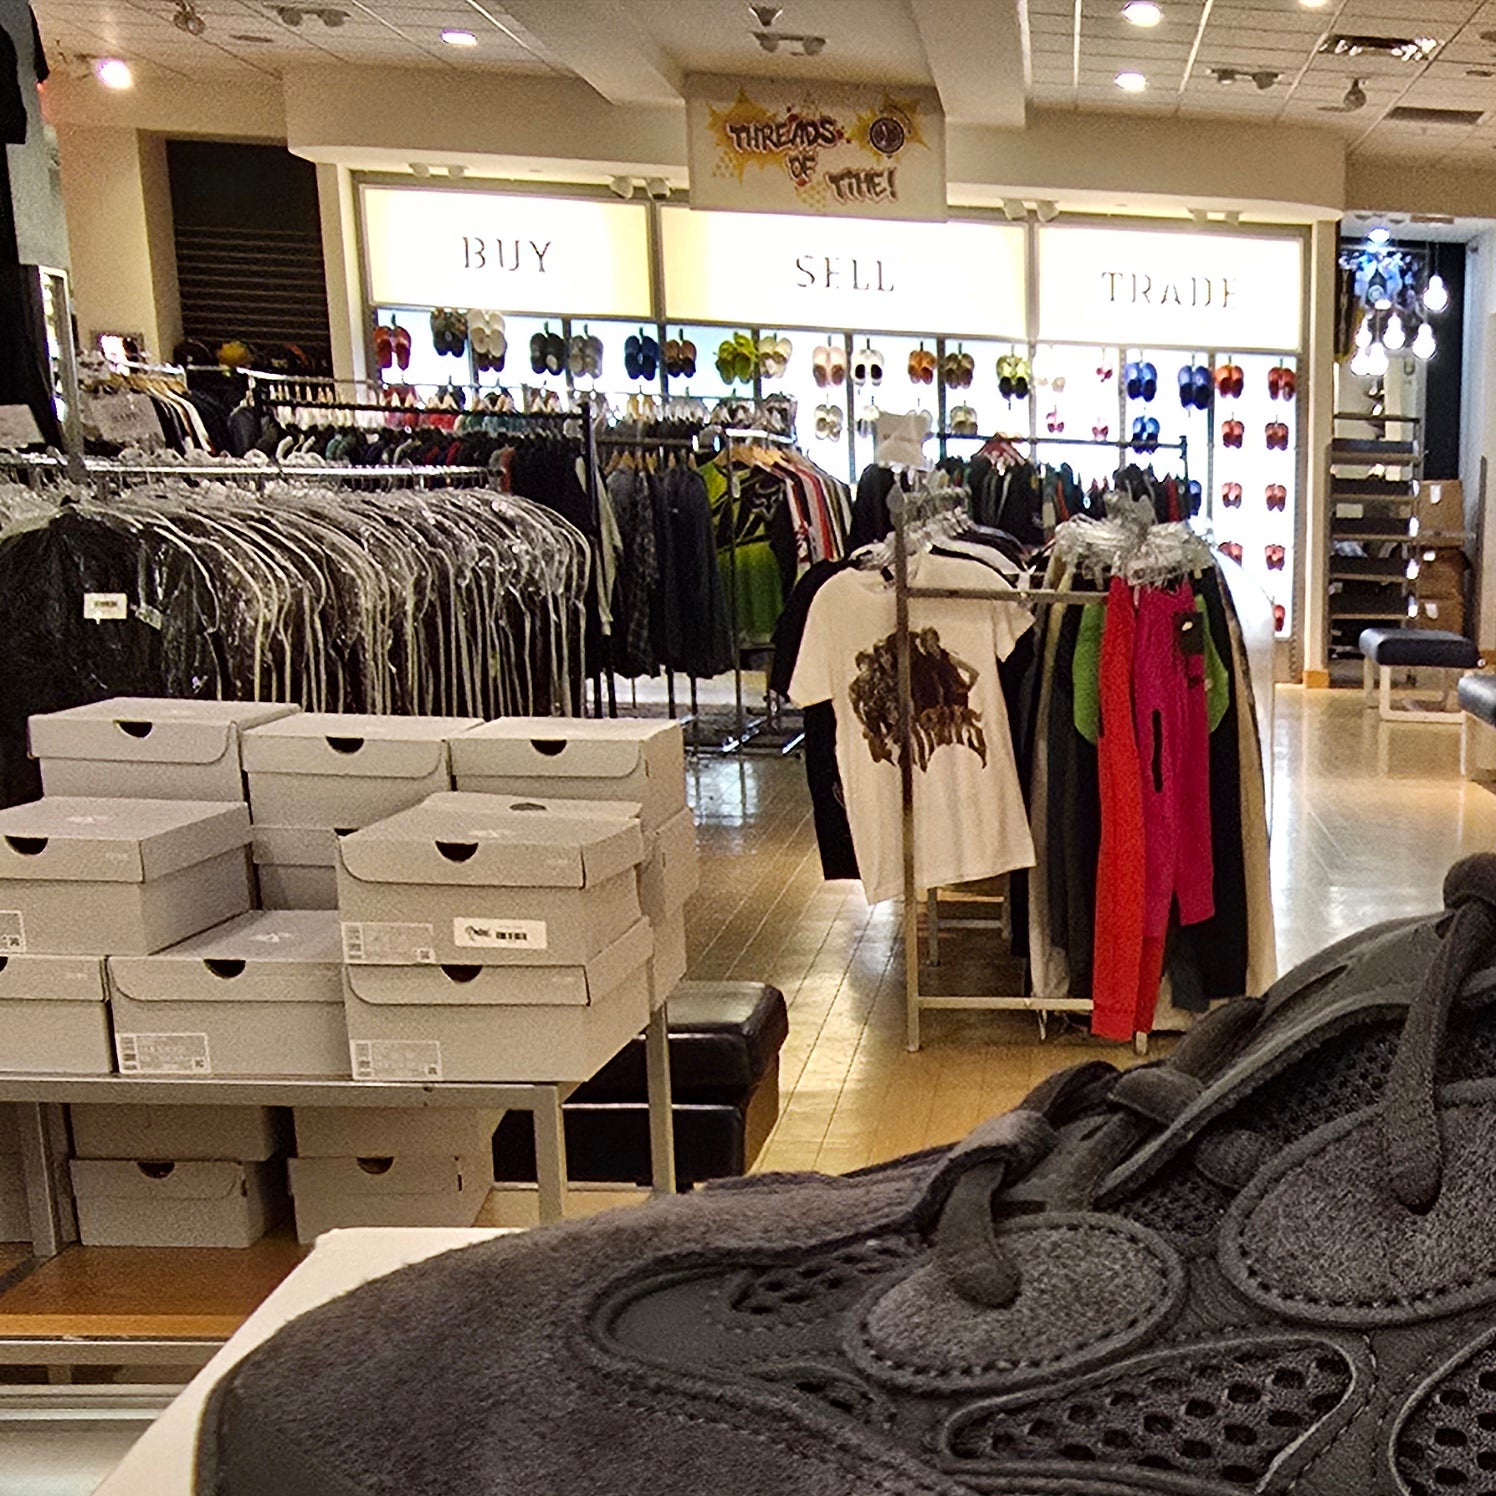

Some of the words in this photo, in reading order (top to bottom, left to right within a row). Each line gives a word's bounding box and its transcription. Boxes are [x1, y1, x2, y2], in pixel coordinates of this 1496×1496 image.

[728, 115, 838, 152] THREADS
[787, 154, 817, 182] OF
[462, 236, 551, 273] BUY
[796, 255, 894, 291] SELL
[1101, 271, 1236, 308] TRADE
